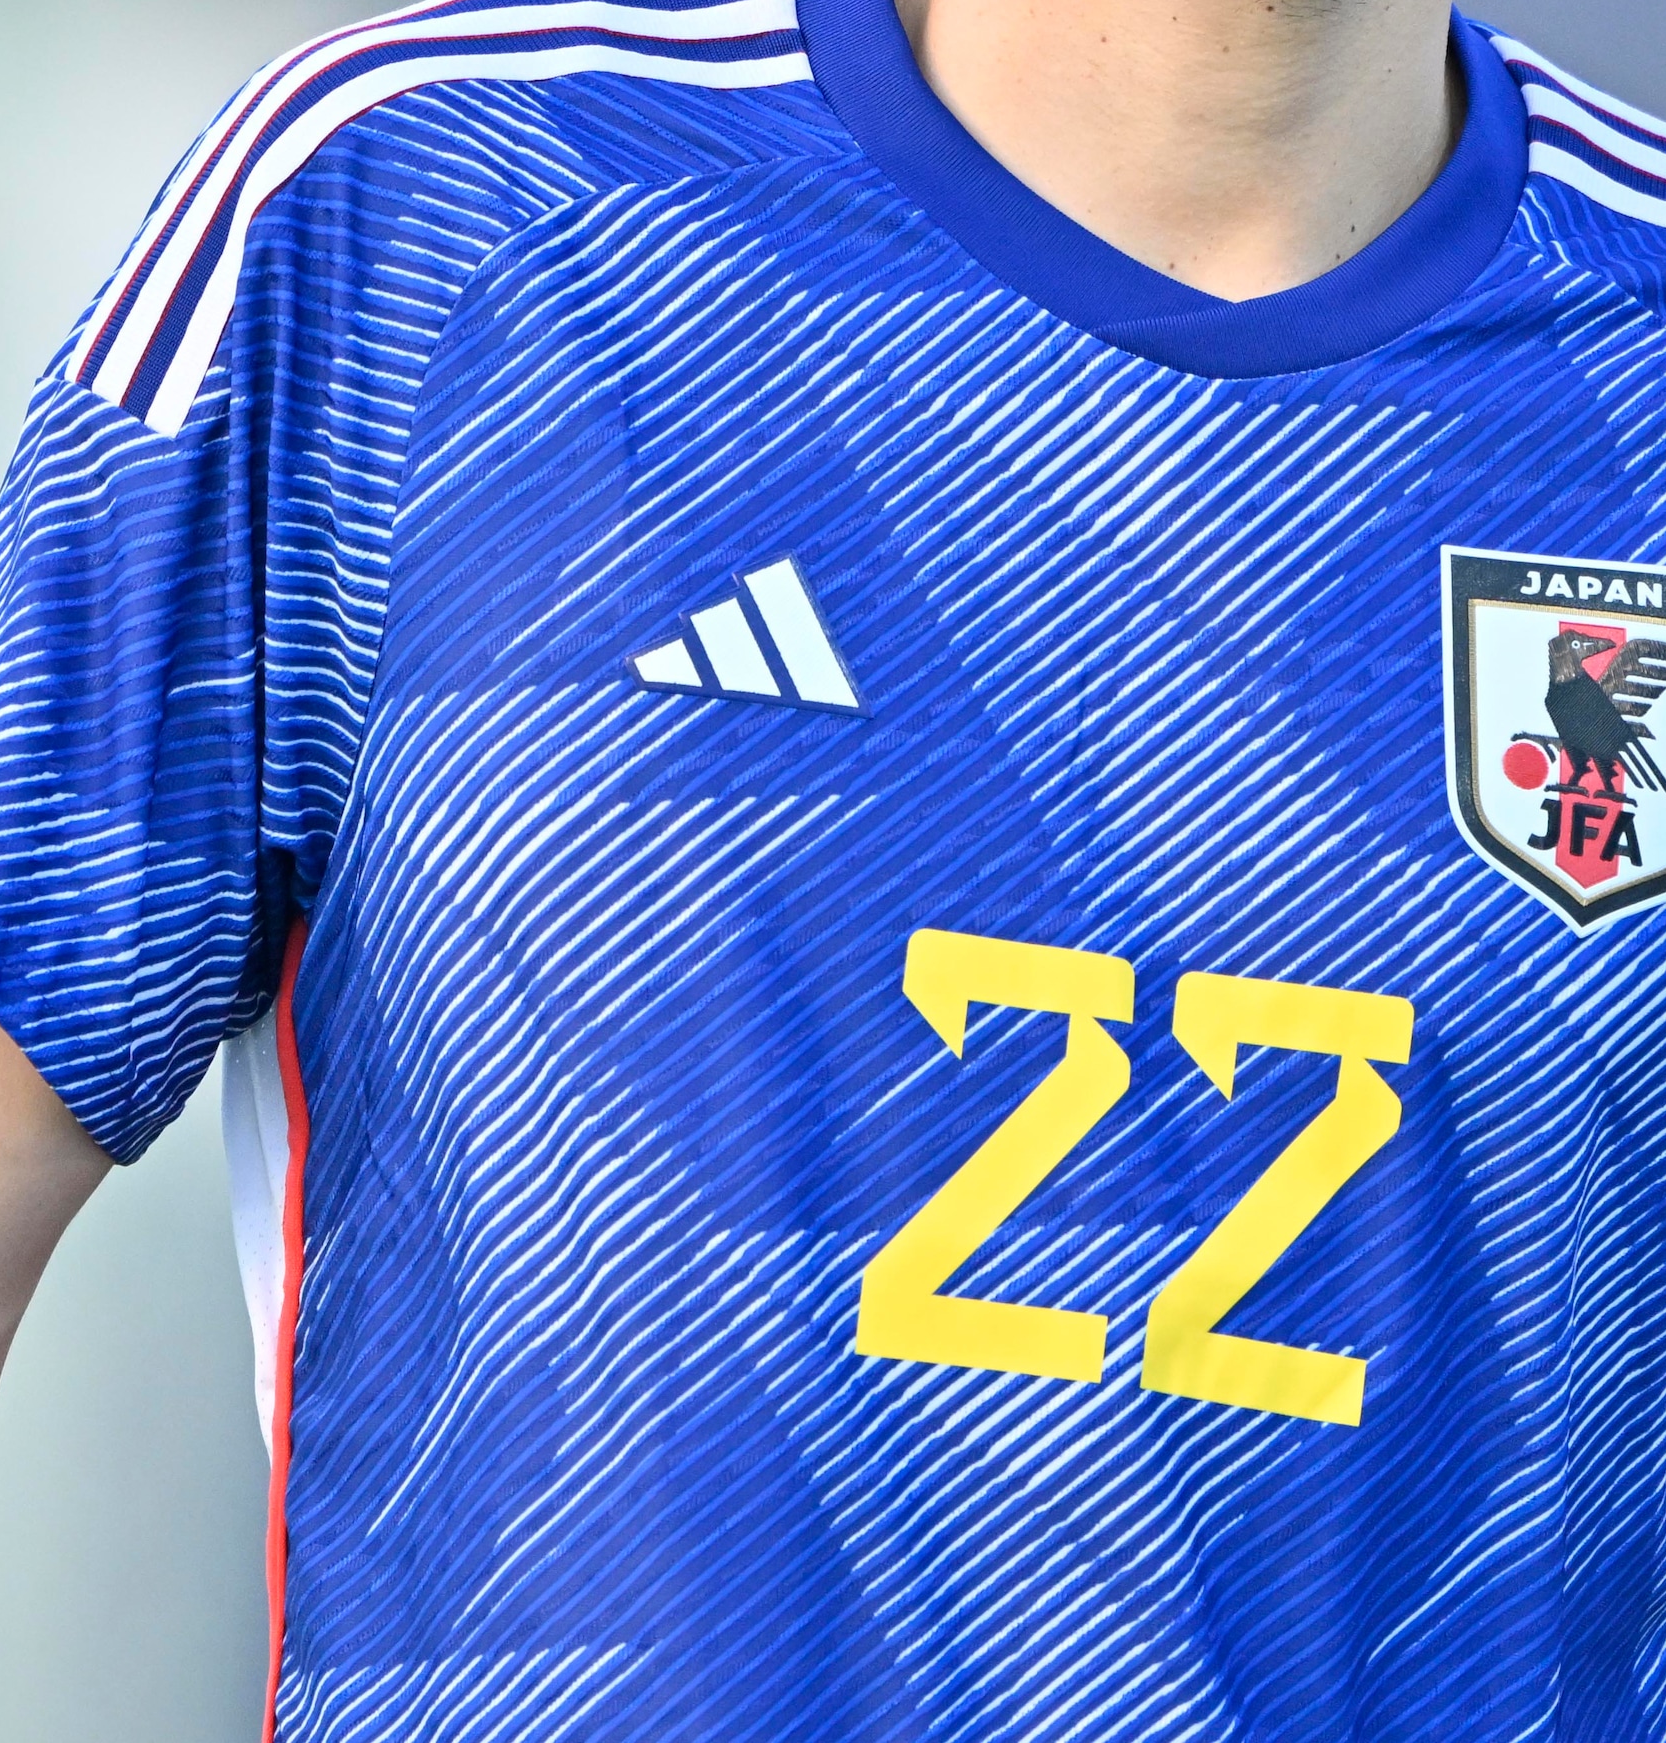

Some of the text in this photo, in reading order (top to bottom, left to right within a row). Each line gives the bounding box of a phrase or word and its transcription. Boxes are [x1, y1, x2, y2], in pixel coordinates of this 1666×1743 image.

[1520, 570, 1663, 608] JAPAN
[1527, 799, 1643, 867] JFA
[855, 927, 1415, 1427] 22
